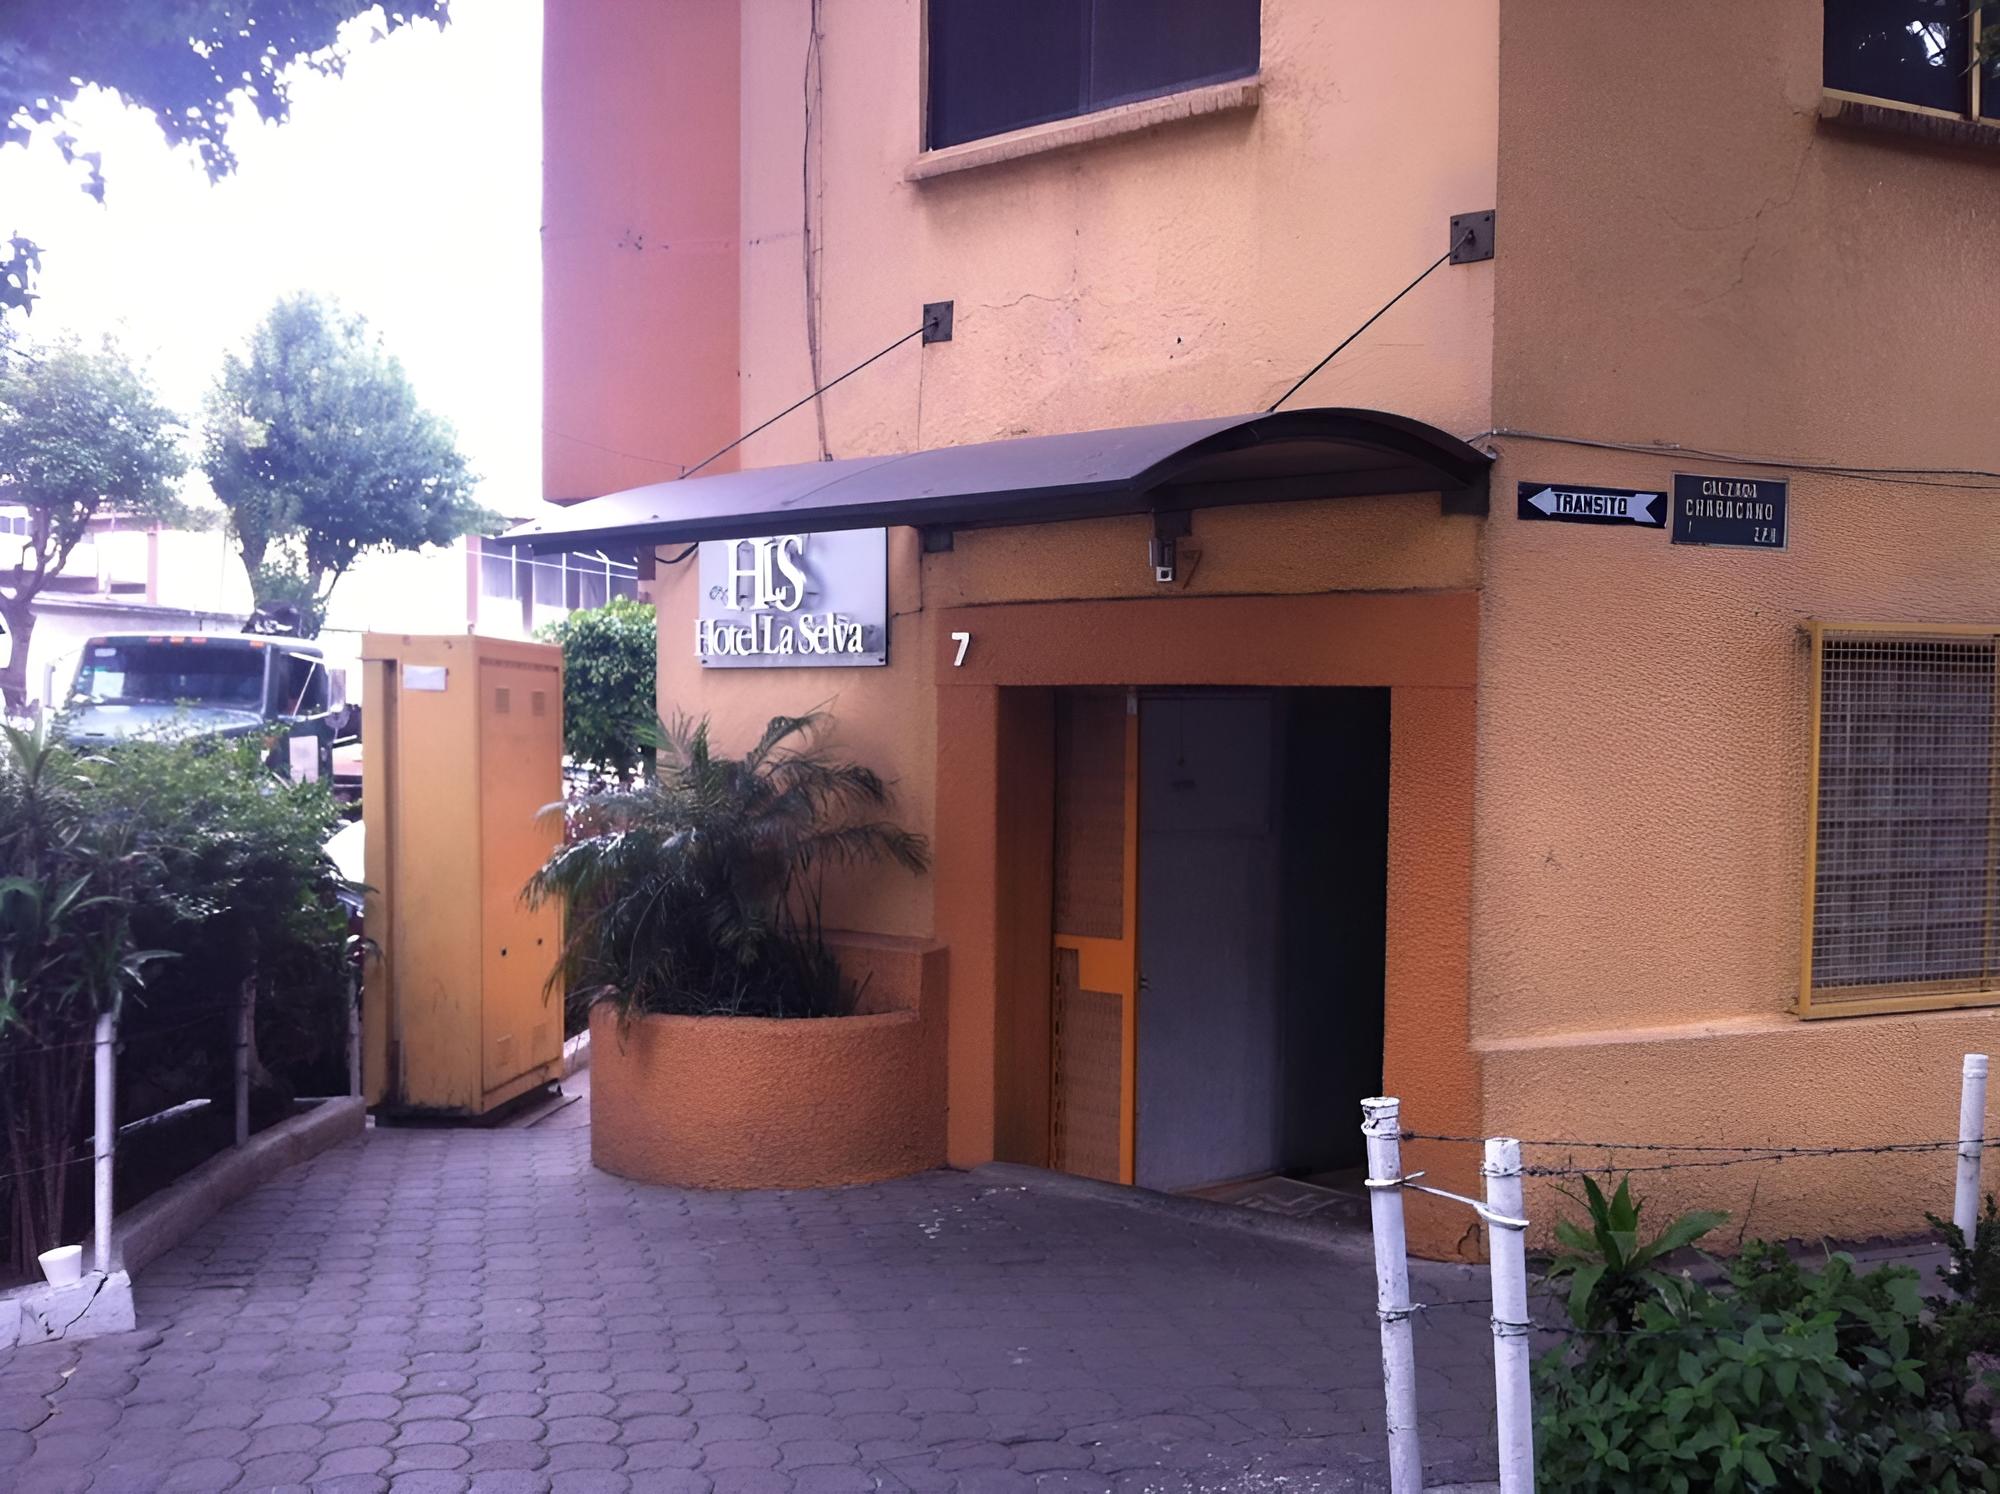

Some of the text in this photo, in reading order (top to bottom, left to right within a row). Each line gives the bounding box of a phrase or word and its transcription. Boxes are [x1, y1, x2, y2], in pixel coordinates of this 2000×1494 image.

[1554, 493, 1627, 515] TRANSITO
[1685, 498, 1774, 520] CHABACANO
[694, 612, 863, 656] Hotel La Selva
[951, 632, 970, 667] 7
